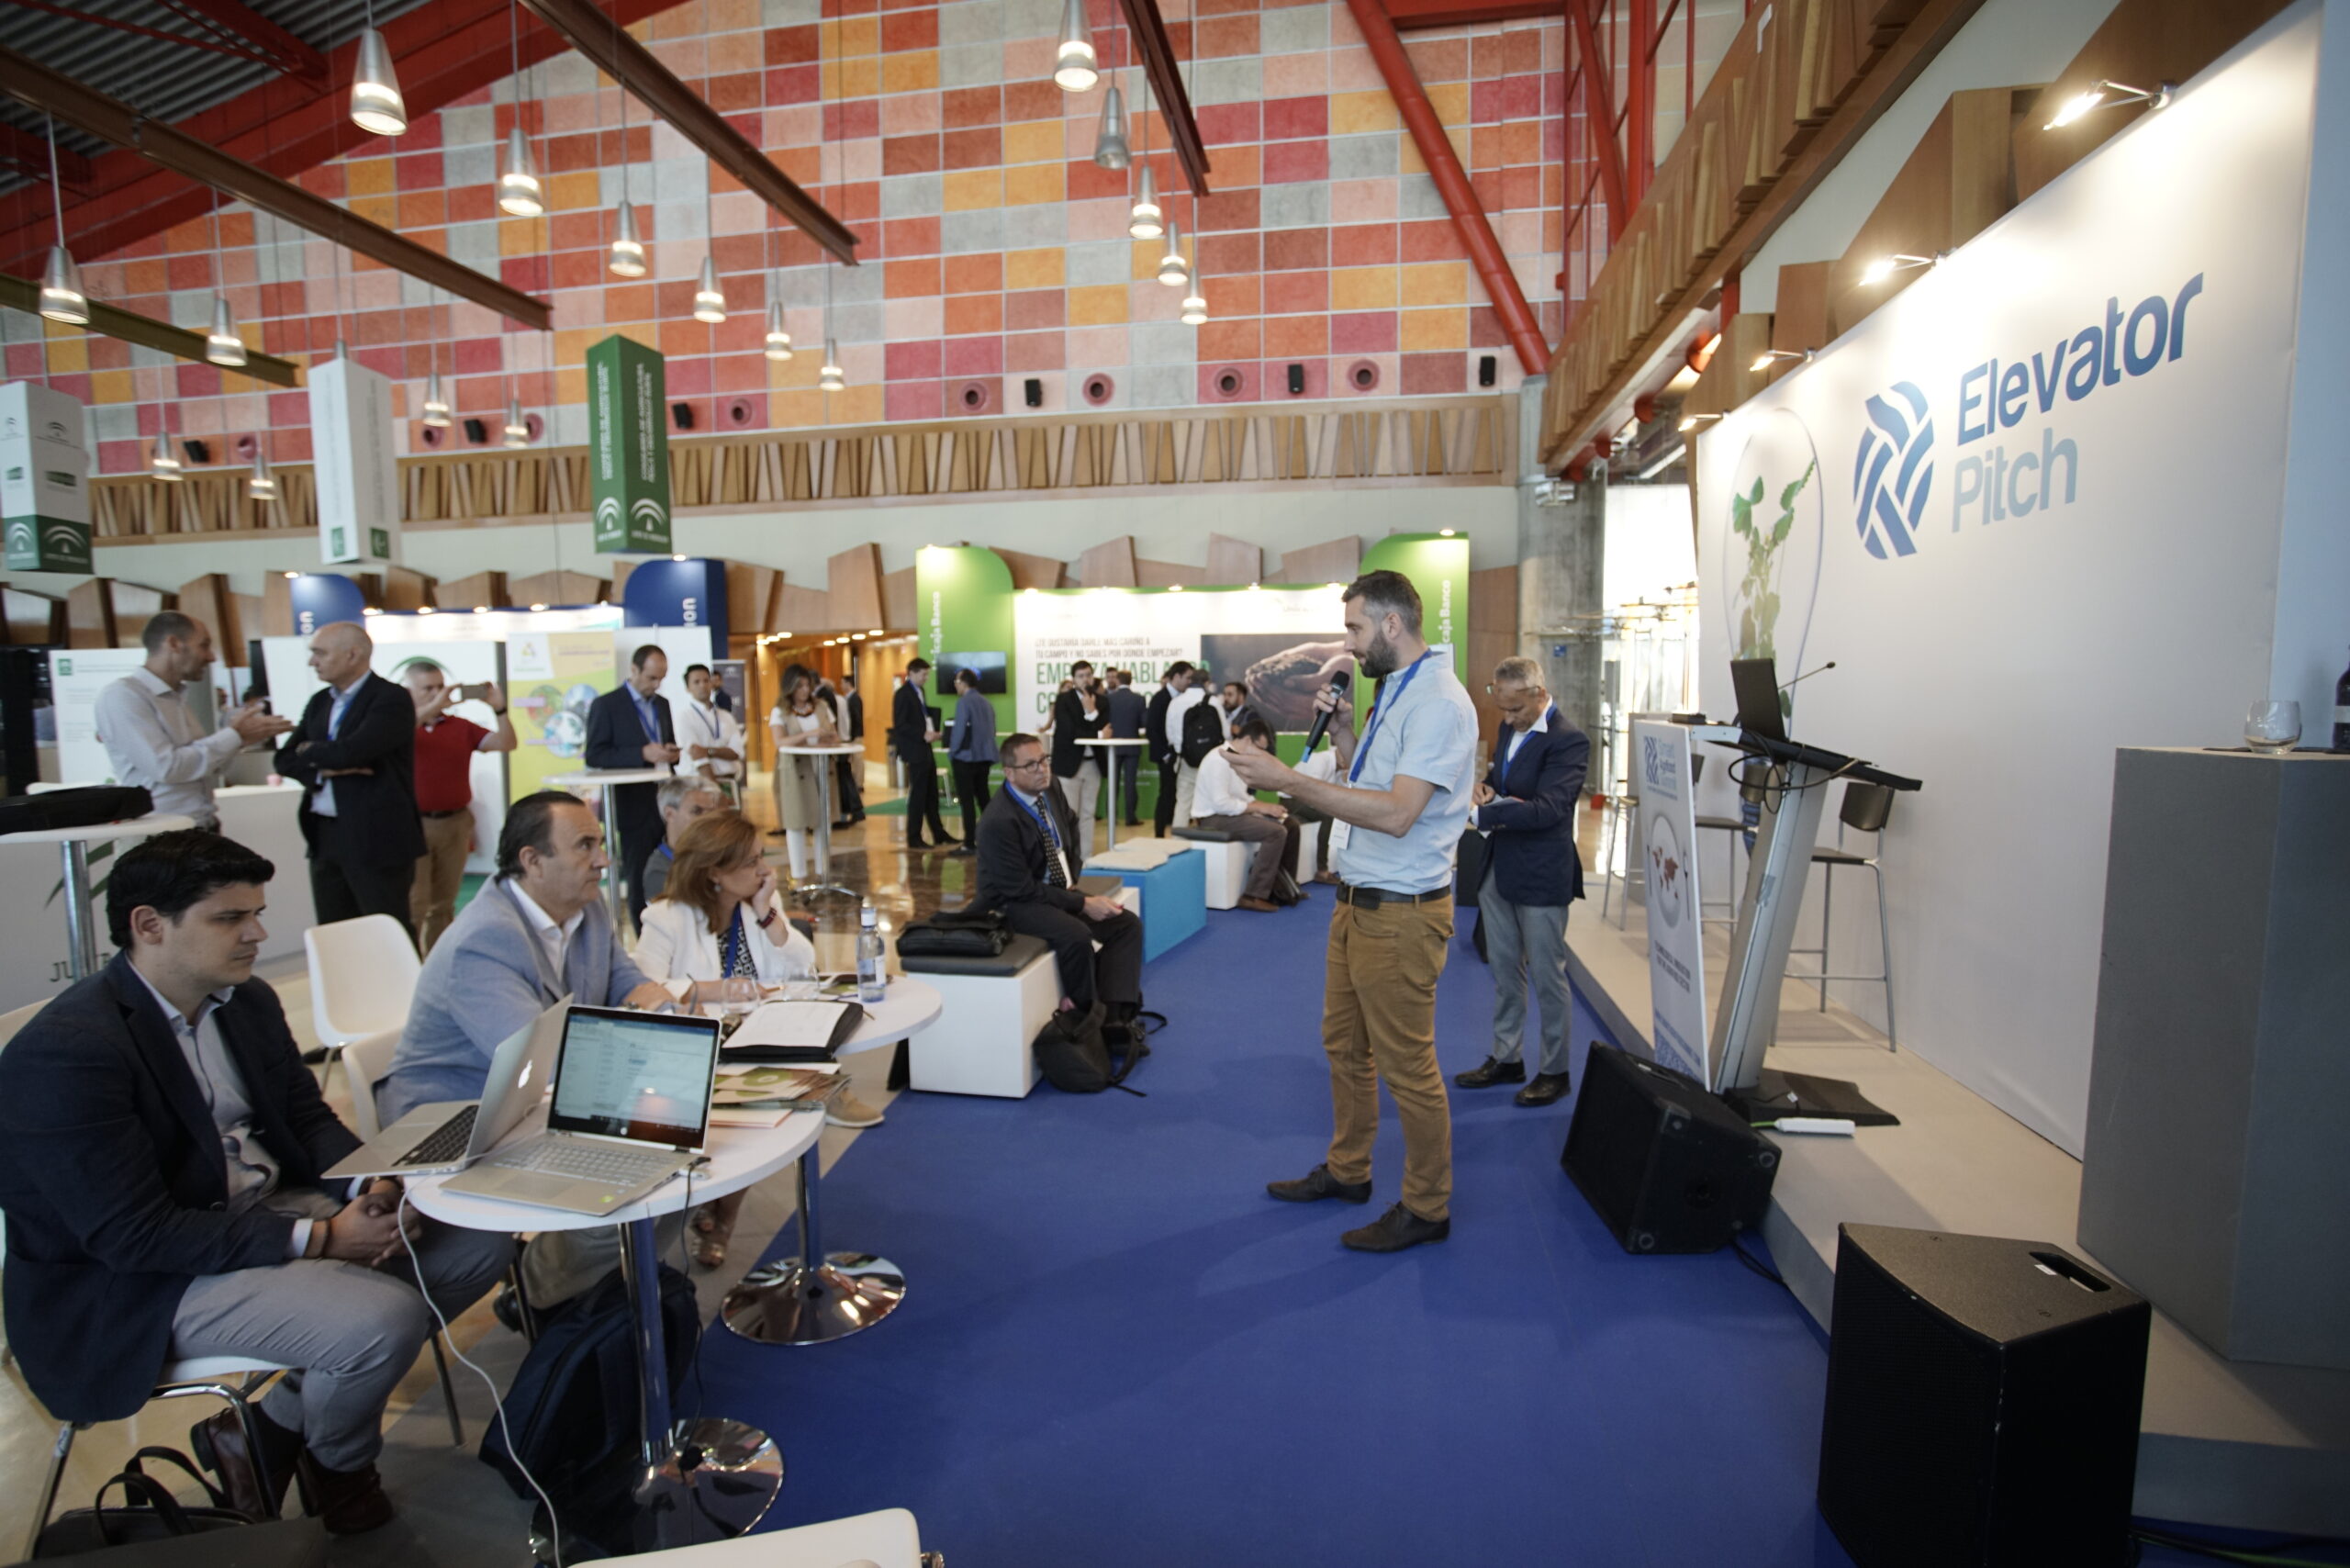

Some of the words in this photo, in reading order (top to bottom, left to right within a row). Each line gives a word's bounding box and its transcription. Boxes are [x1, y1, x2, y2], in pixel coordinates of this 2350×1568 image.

[1957, 272, 2204, 446] Elevator
[1952, 427, 2078, 533] Pitch
[930, 590, 941, 626] Banco
[1439, 579, 1451, 617] Banco
